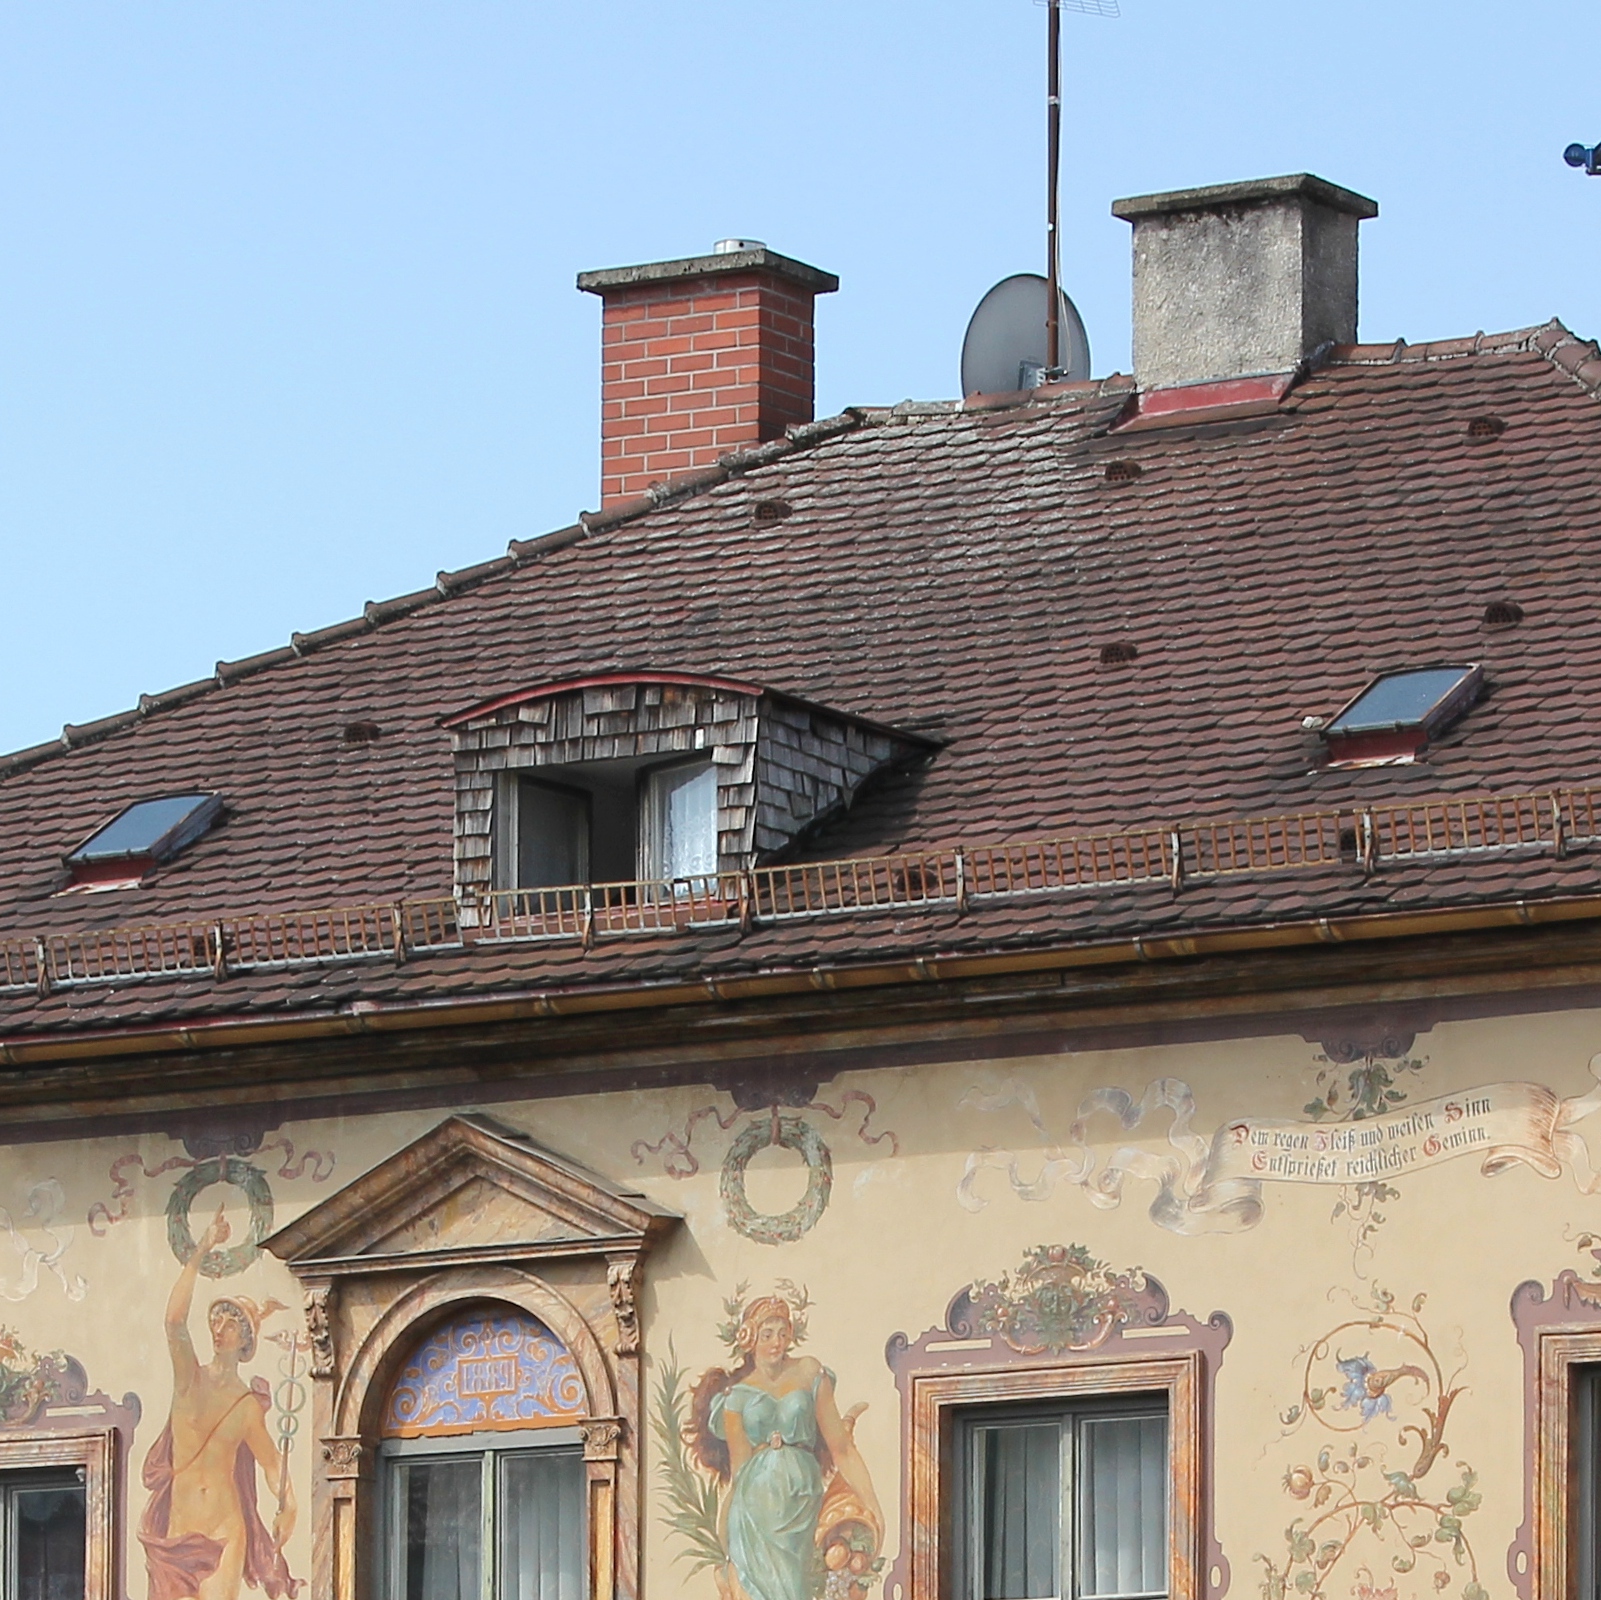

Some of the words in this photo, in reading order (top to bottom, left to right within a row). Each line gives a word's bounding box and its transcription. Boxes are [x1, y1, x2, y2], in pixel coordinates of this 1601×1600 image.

[1229, 1124, 1268, 1146] Dem
[1273, 1132, 1309, 1151] regen
[1314, 1128, 1356, 1153] Fleiß
[1360, 1123, 1384, 1147] und
[1444, 1098, 1491, 1124] Sinn
[1346, 1144, 1417, 1177] reichlicher
[1422, 1127, 1491, 1157] Gewinn.
